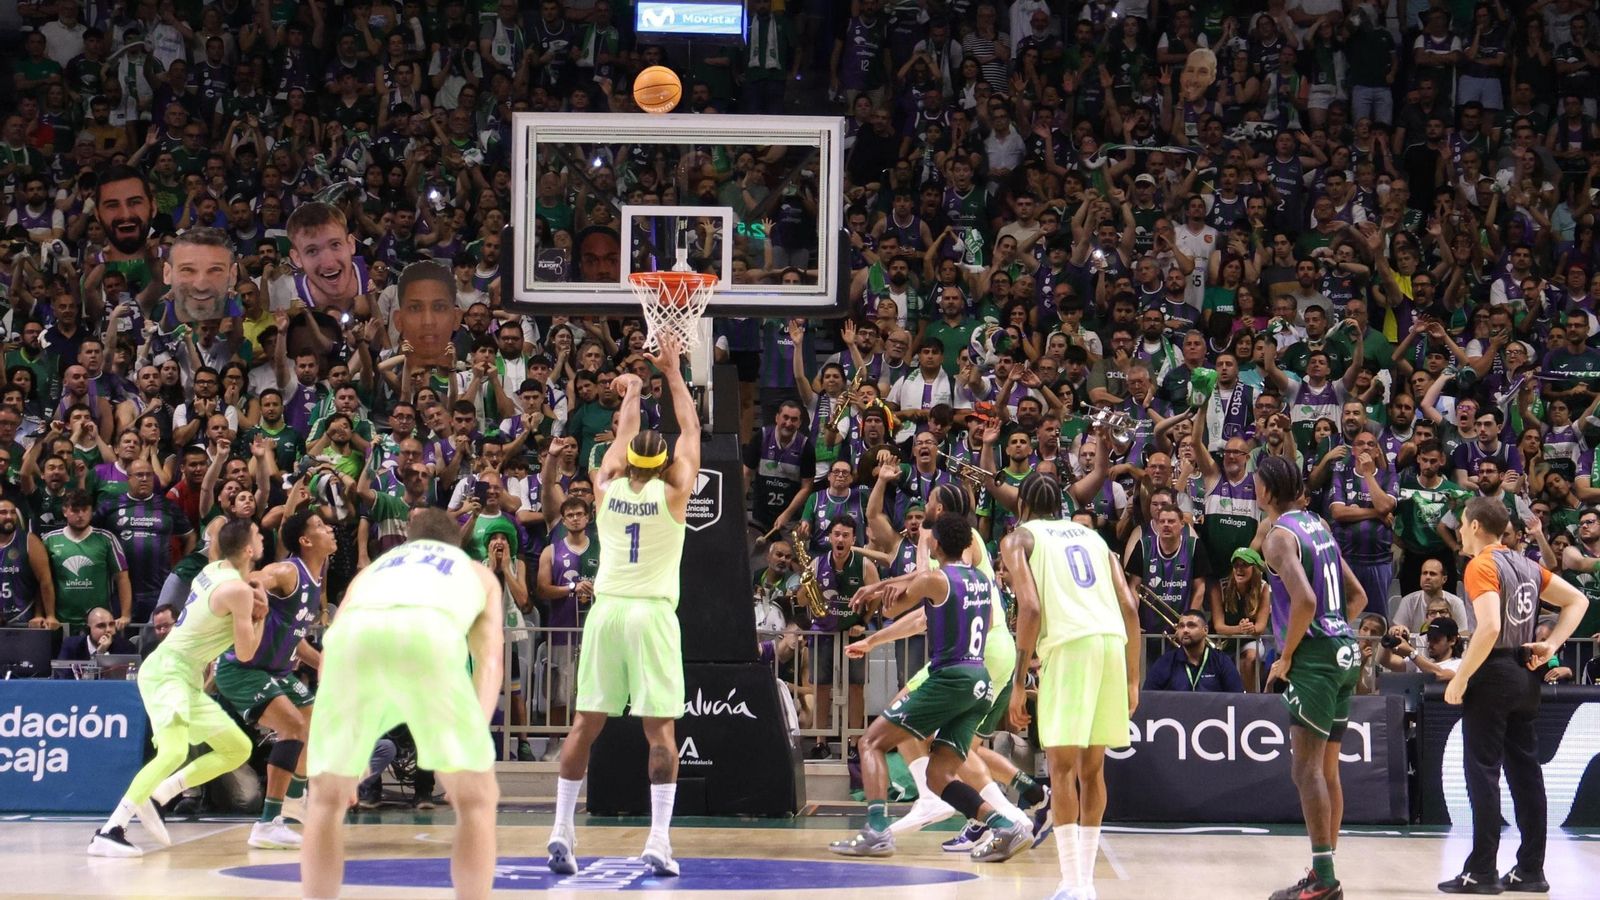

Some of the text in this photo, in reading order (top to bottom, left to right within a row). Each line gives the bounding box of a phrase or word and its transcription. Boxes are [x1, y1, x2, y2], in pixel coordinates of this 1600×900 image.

[682, 14, 736, 24] Movistar
[608, 497, 659, 516] ANDERSON
[767, 492, 784, 506] 25
[625, 523, 640, 563] 1
[1065, 544, 1097, 588] 0
[65, 577, 95, 589] Unicaja
[962, 578, 989, 596] Taylor
[1161, 579, 1188, 590] Unicaja
[1323, 562, 1341, 611] 11
[969, 615, 984, 657] 6
